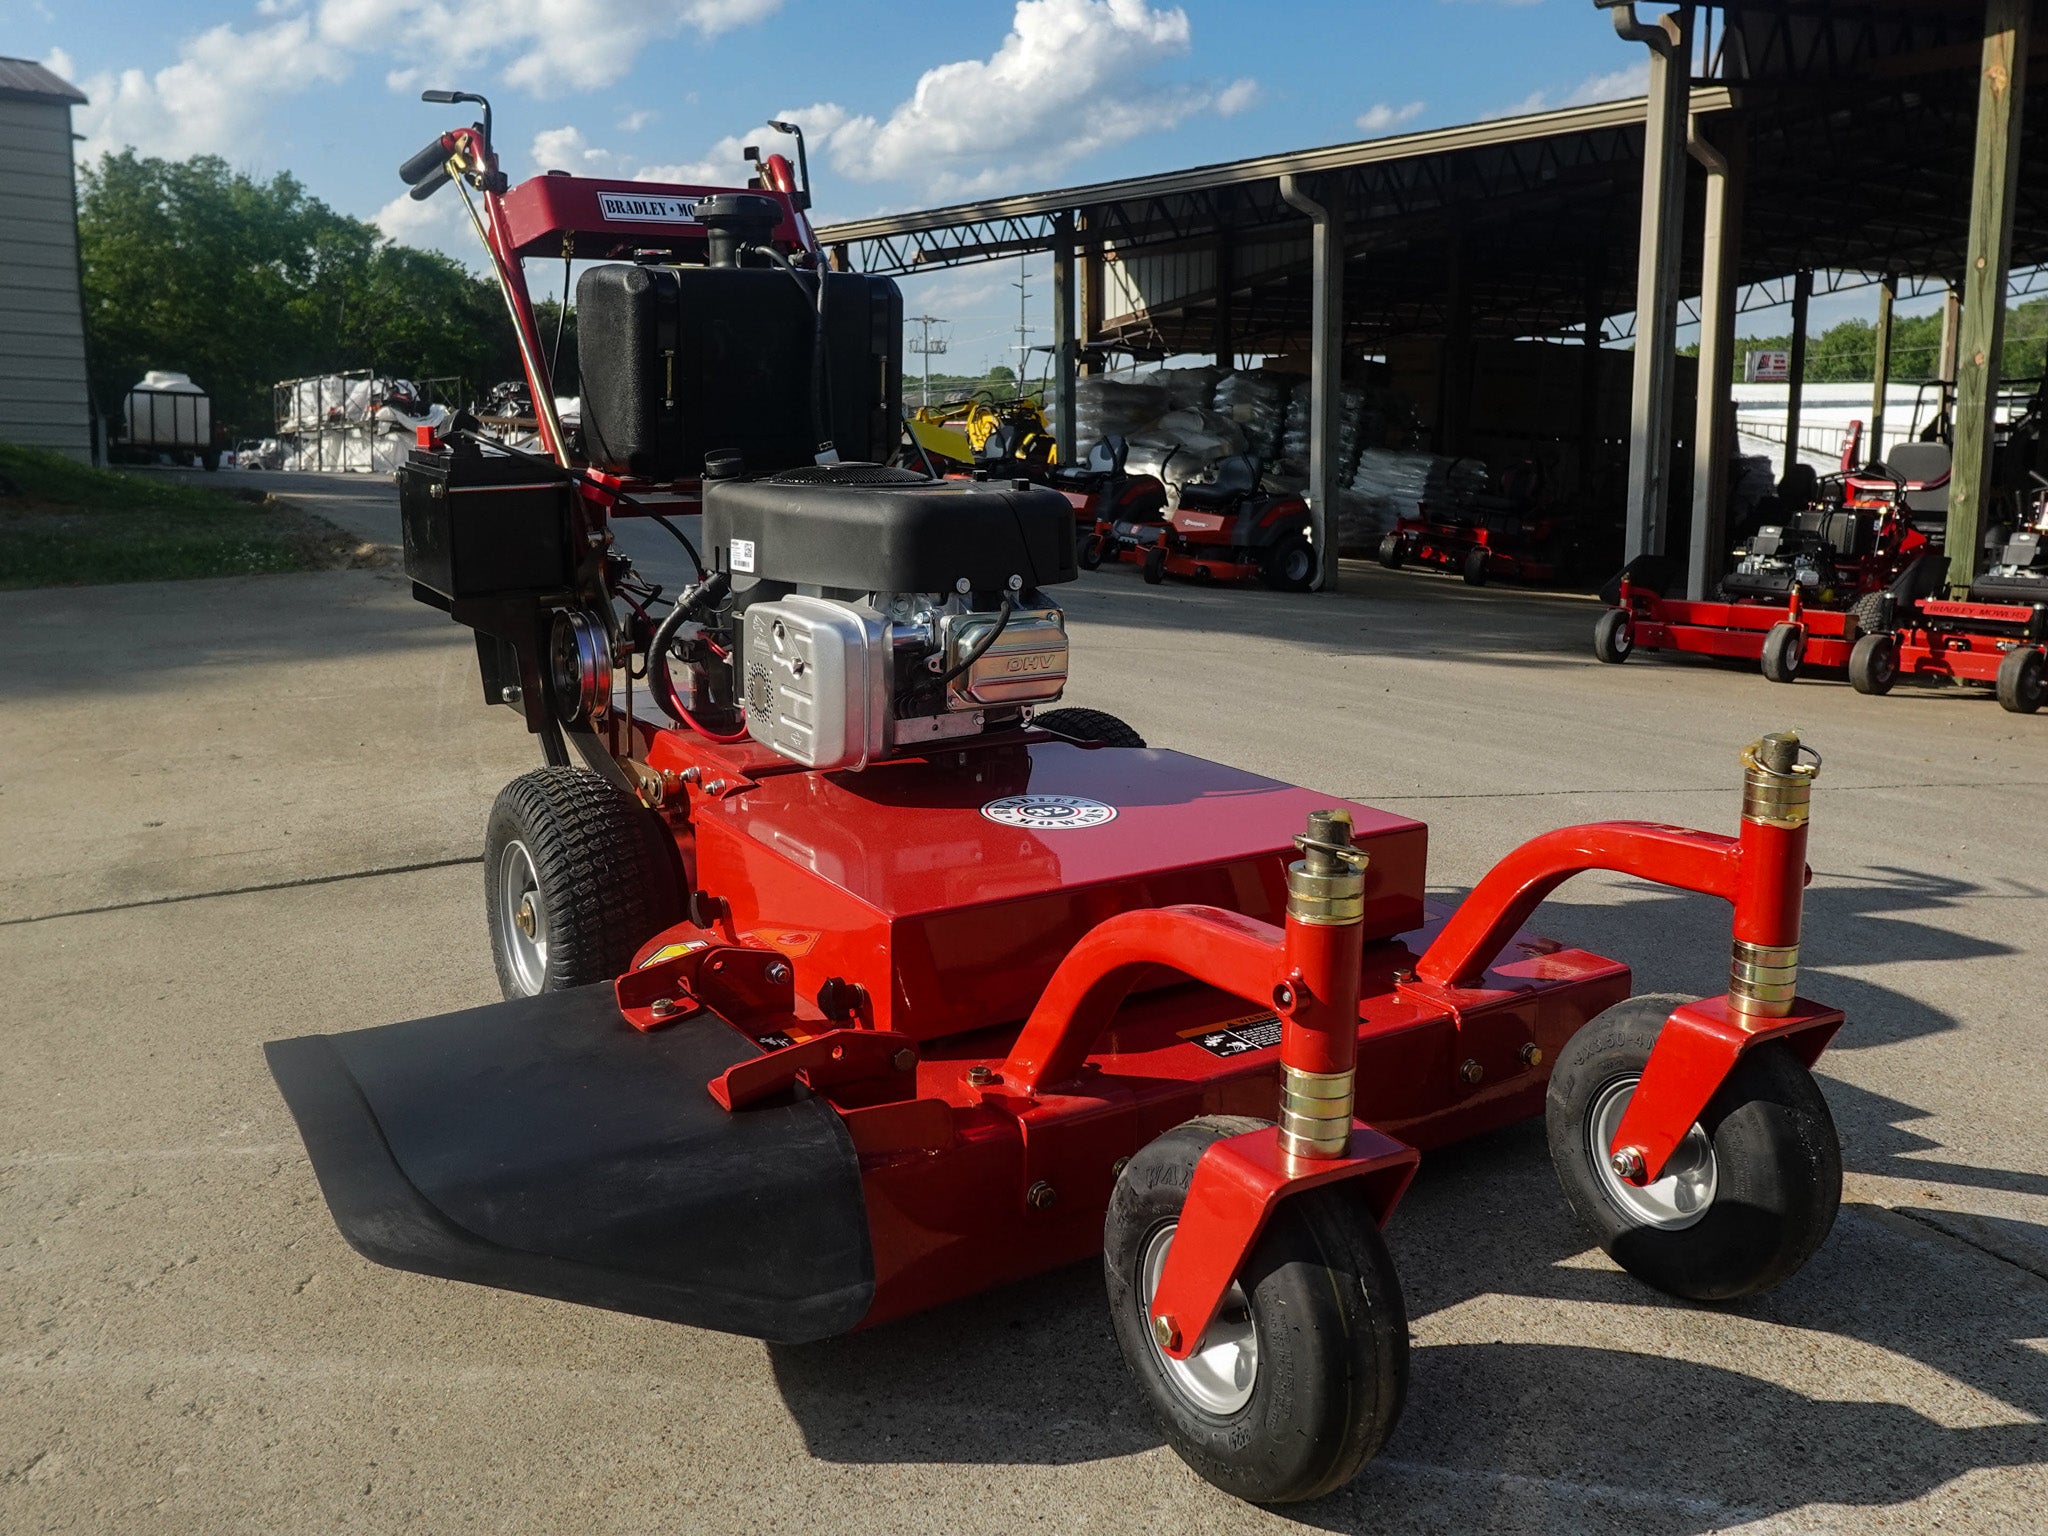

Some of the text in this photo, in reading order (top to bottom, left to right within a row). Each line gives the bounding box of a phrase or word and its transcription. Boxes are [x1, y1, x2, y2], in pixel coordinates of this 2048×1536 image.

[604, 199, 667, 216] BRADLEY
[1929, 604, 2027, 619] BRADLEY MOWERS
[1007, 654, 1055, 672] OHV
[993, 797, 1084, 815] BRADLEY
[1026, 806, 1070, 817] 32
[1015, 808, 1104, 826] MOWERS
